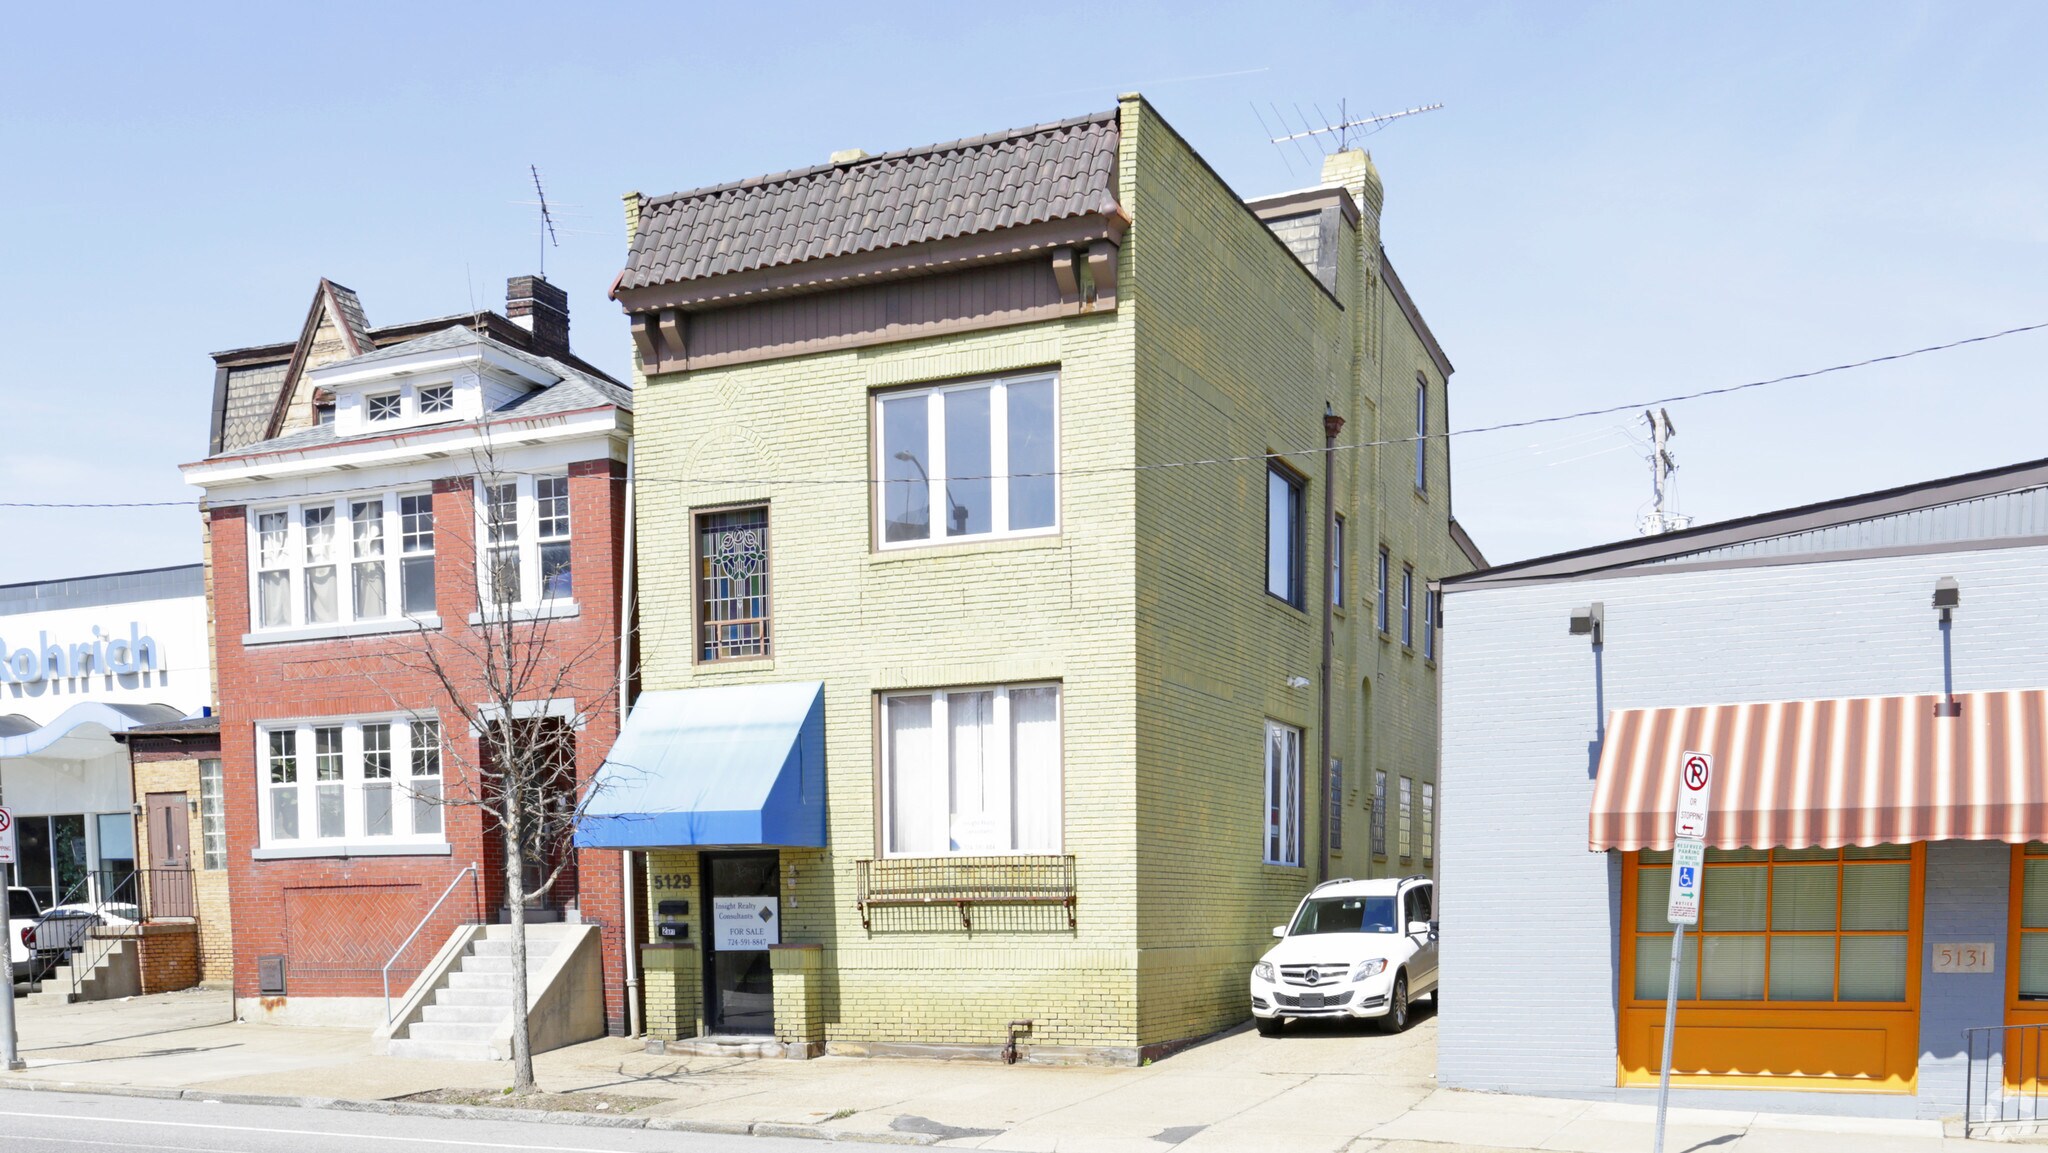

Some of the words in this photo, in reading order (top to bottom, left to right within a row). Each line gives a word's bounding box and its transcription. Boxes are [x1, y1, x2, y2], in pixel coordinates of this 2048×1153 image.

[1690, 797, 1697, 806] OR
[1680, 811, 1704, 821] STOPPING
[654, 874, 692, 890] 5129
[715, 902, 736, 910] Insight
[738, 902, 757, 910] Realty
[730, 928, 744, 936] FOR
[746, 928, 765, 936] SALE
[1940, 949, 1987, 967] 5131
